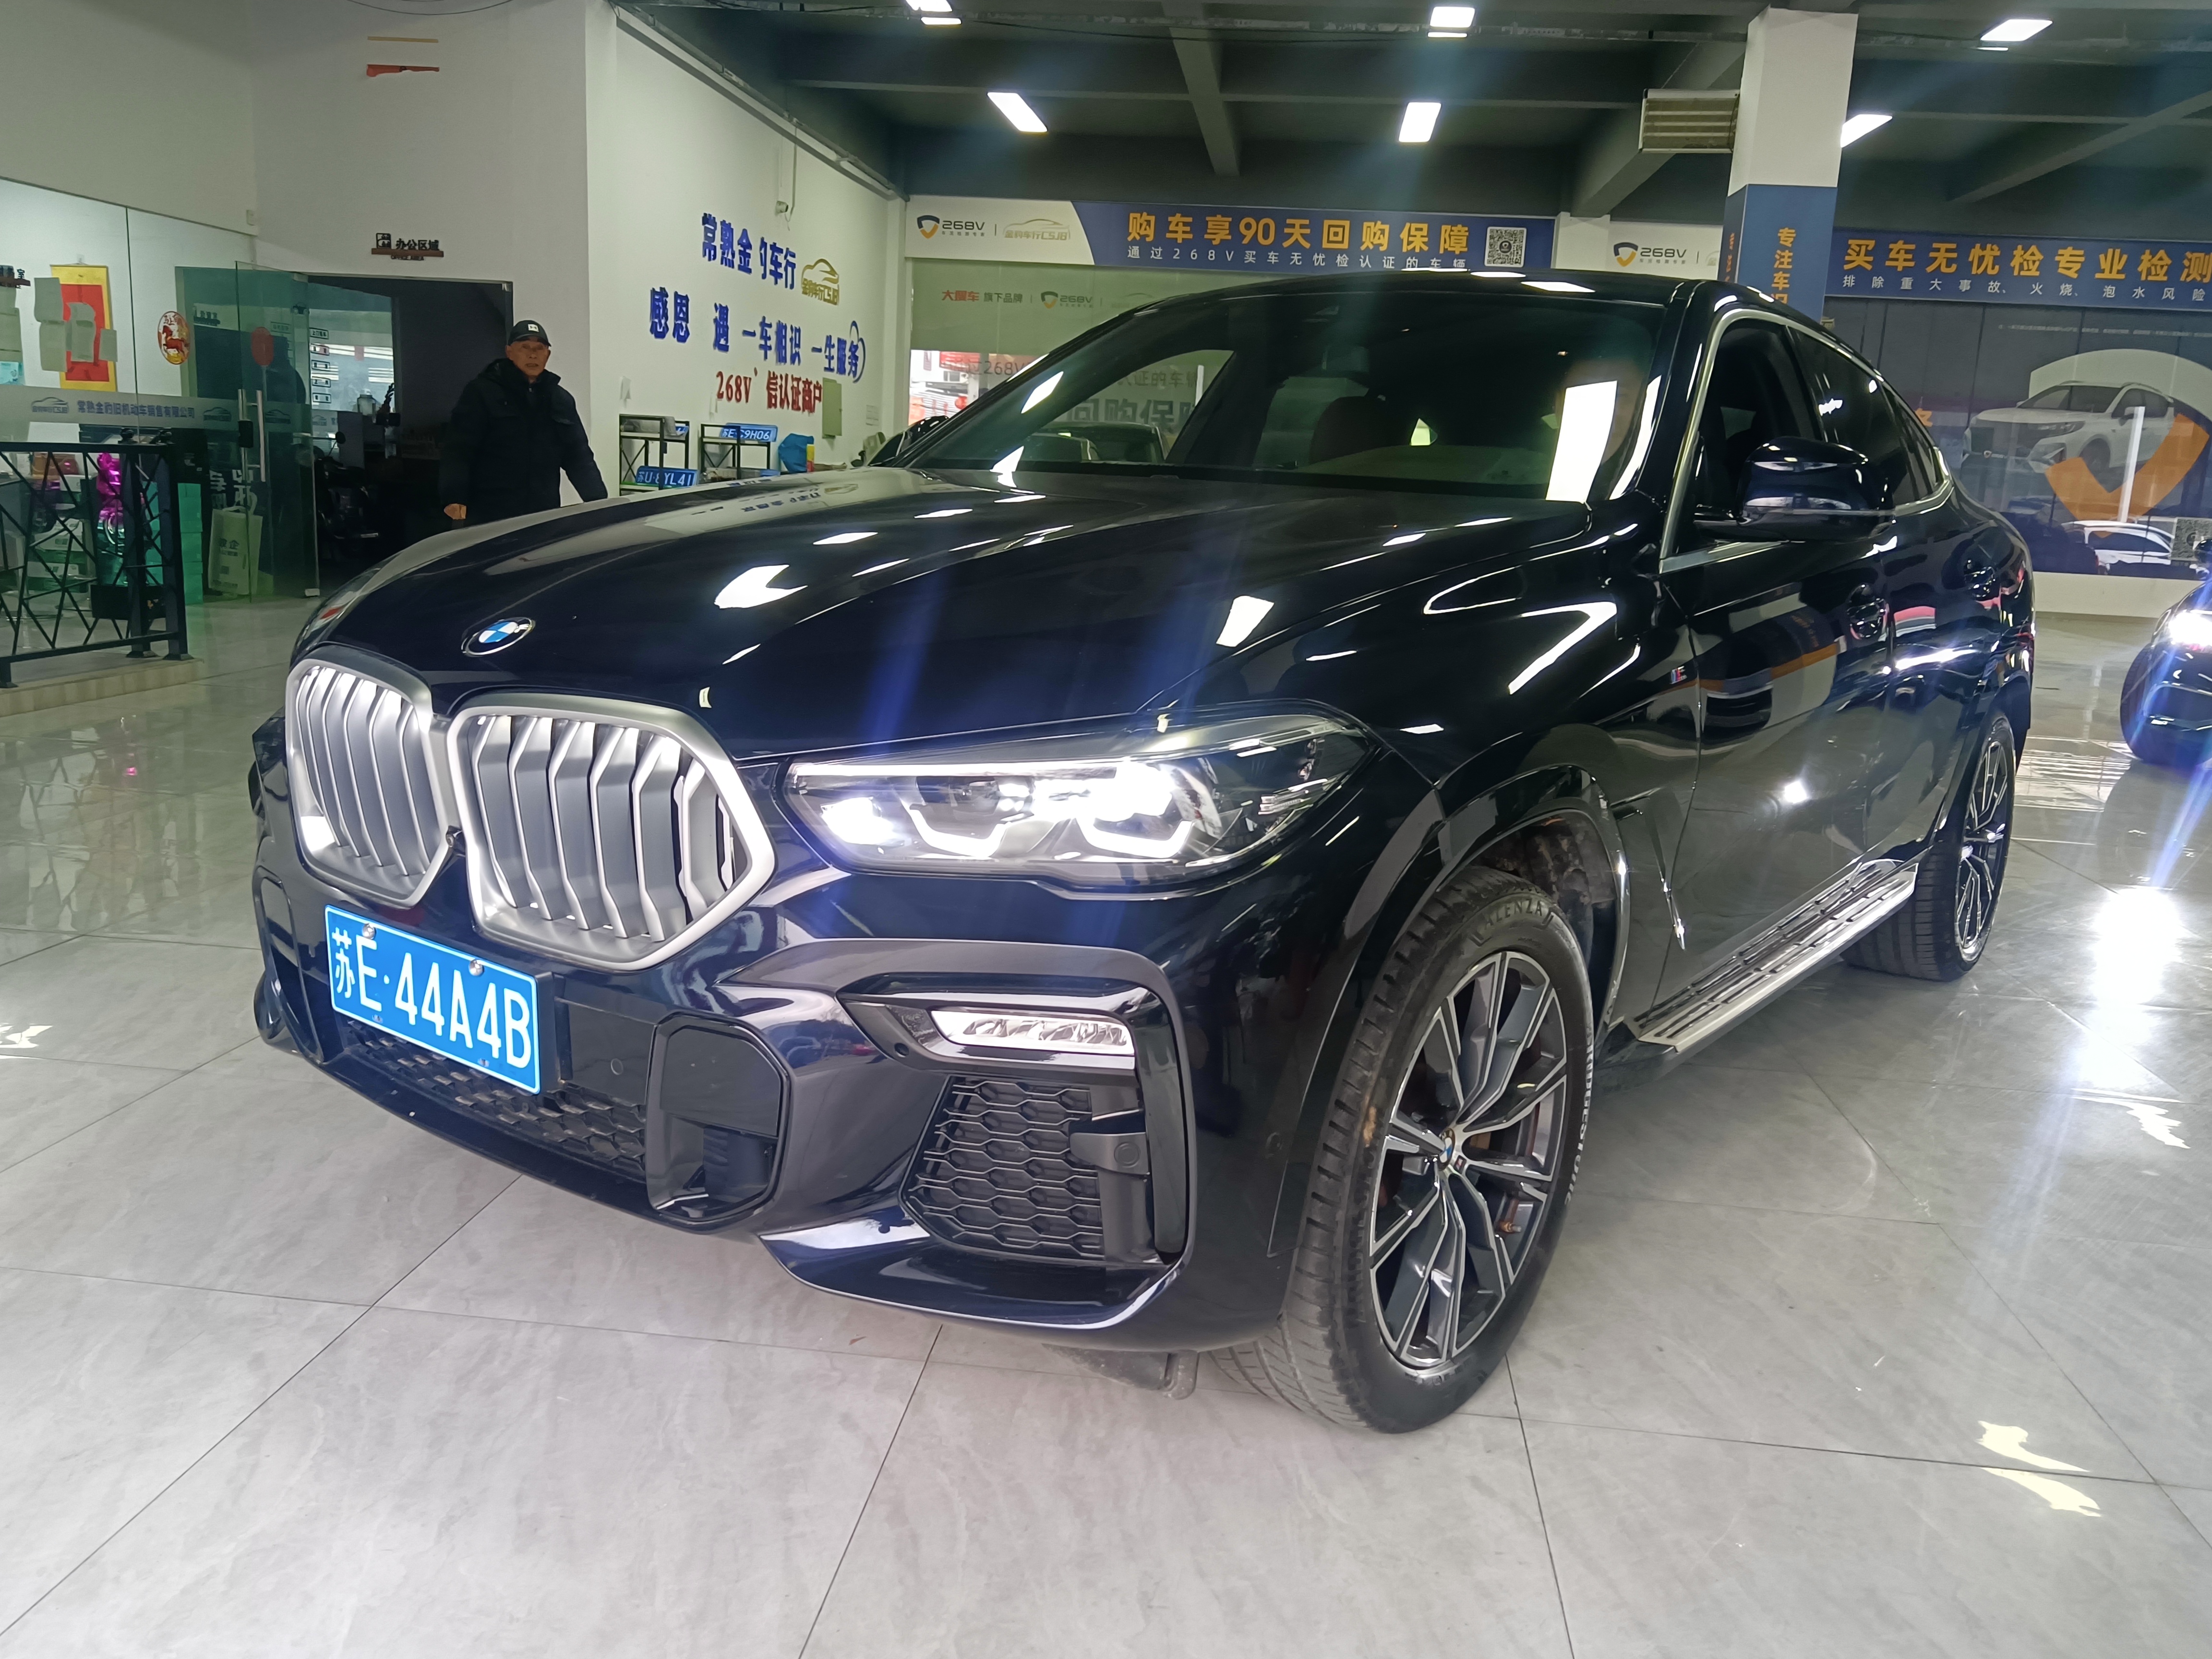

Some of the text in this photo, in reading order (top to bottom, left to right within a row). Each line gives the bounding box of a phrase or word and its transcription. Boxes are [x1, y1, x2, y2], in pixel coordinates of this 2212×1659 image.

[942, 220, 985, 230] 268V
[1127, 212, 1469, 254] 购车享90天回购保障
[1640, 248, 1687, 258] 268V
[1843, 240, 2212, 283] 买车无忧检专业检测
[984, 292, 1023, 303] 旗下品牌
[1059, 295, 1093, 303] 268V
[1843, 275, 2205, 301] 排除重大事故、火烧、泡水风险
[716, 371, 752, 404] 268V
[332, 927, 532, 1069] 苏E·44A4B
